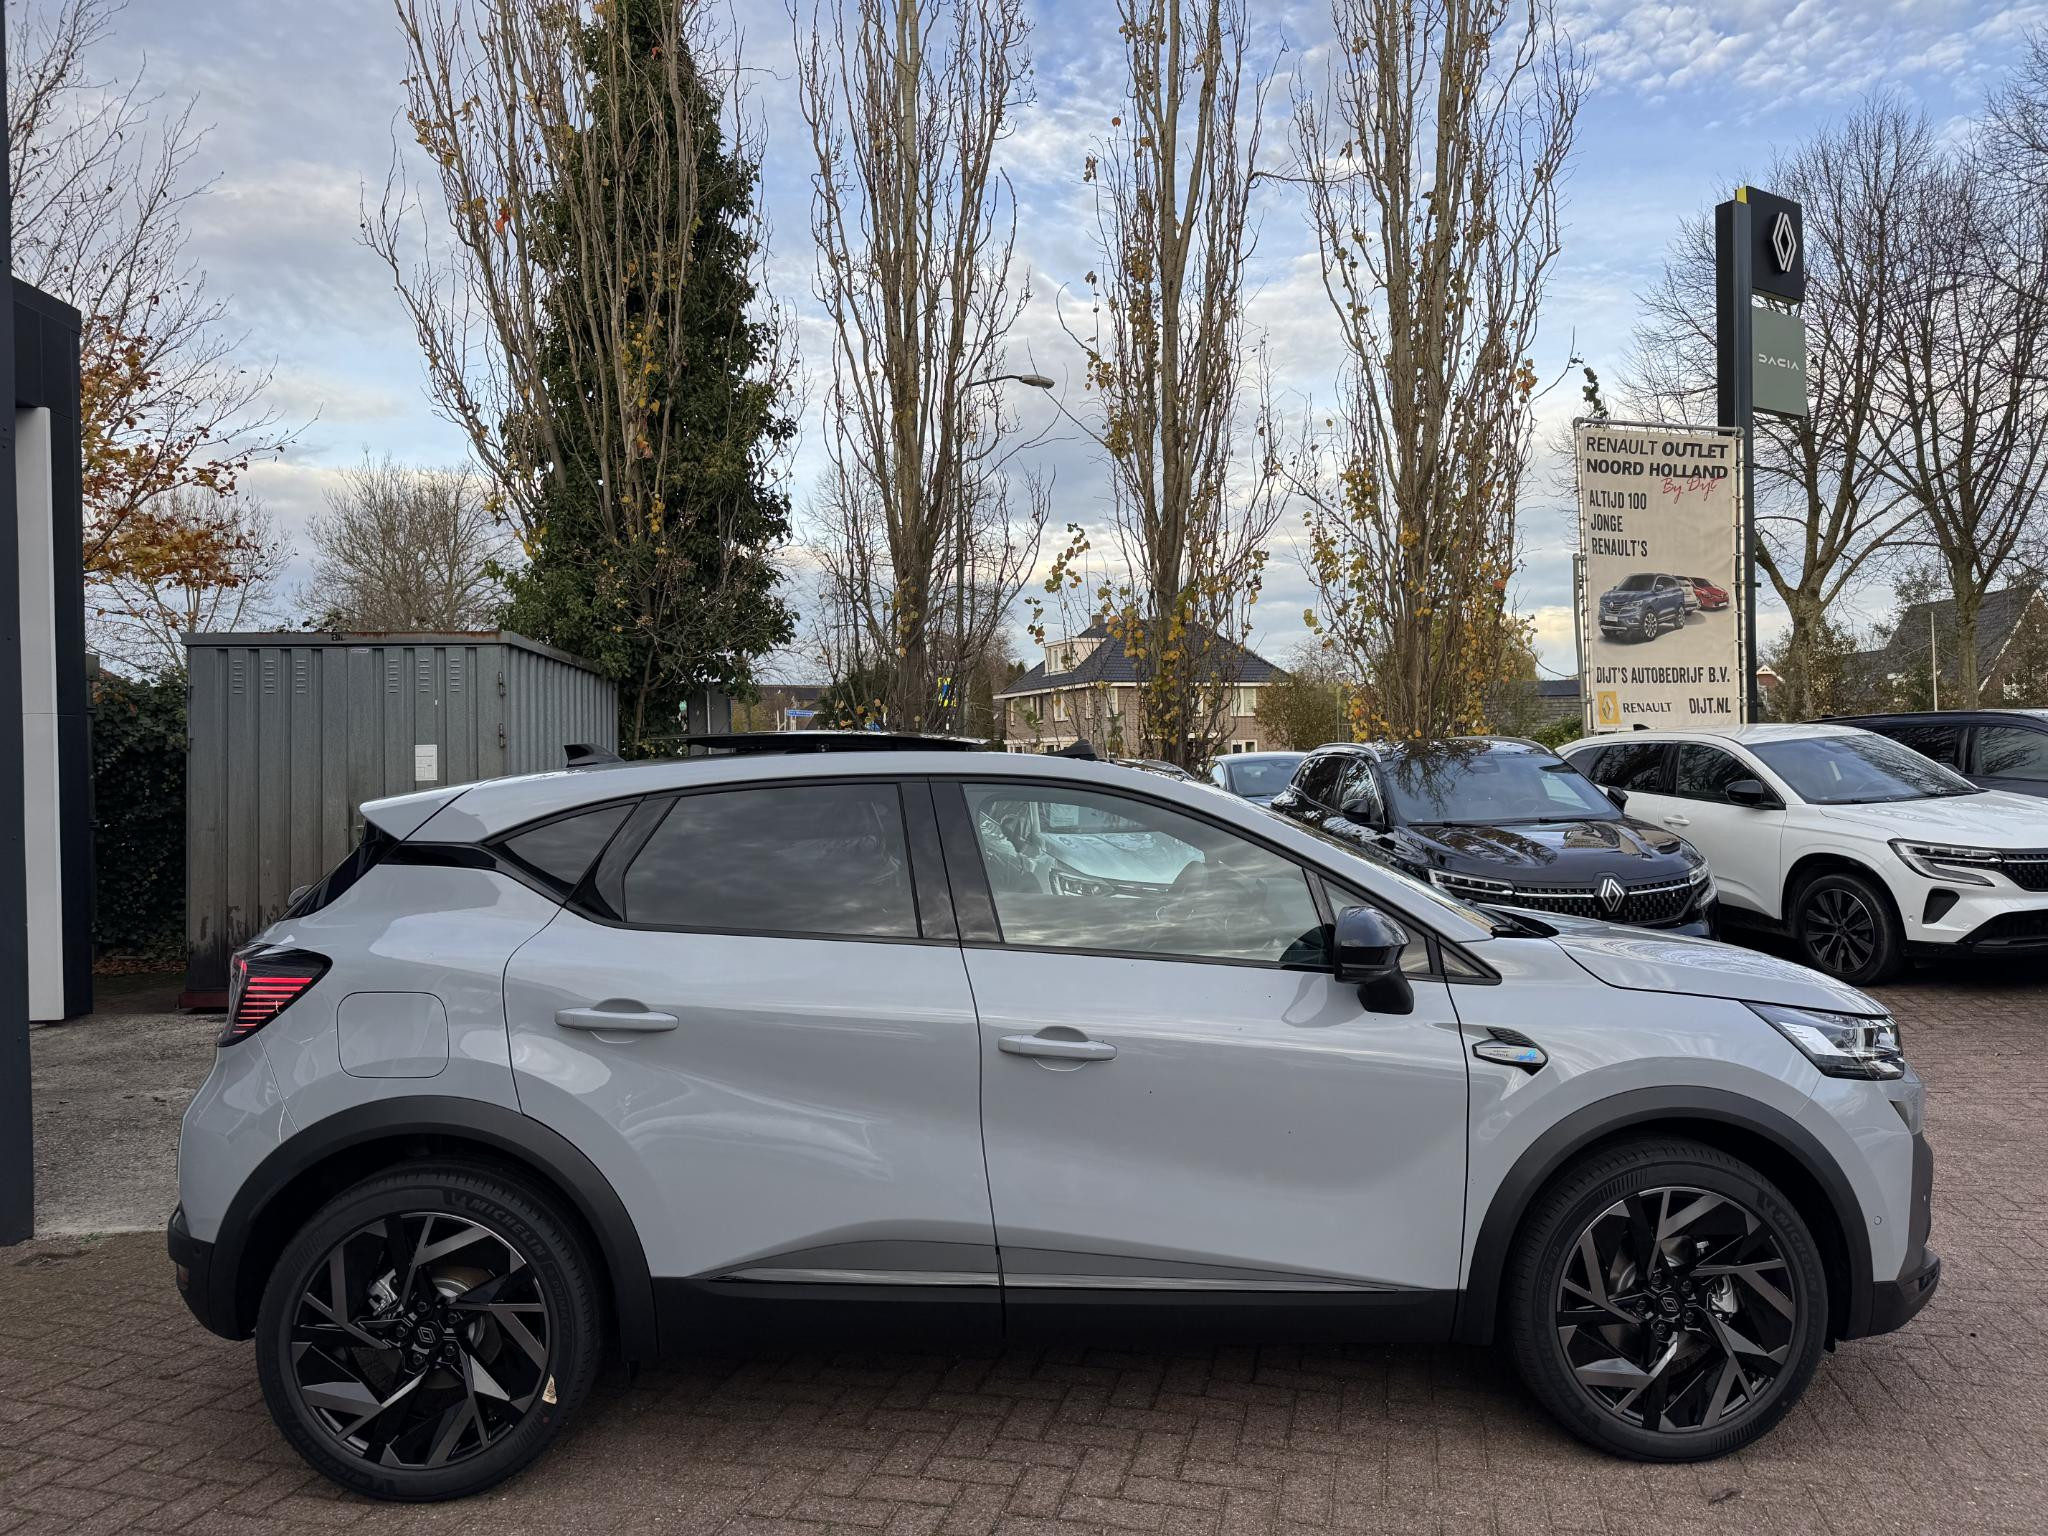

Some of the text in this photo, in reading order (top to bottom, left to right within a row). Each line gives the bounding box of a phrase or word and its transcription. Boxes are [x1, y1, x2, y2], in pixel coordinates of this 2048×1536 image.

[1758, 353, 1799, 370] DACIA
[1586, 436, 1729, 459] RENAULT OUTLET
[1586, 458, 1728, 479] NOORD HOLLAND
[1589, 489, 1647, 510] ALTIJD 100
[1662, 478, 1684, 504] By
[1590, 513, 1623, 533] JONGE
[1591, 537, 1648, 557] RENAULT'S
[1596, 666, 1731, 684] DIJT'S AUTOBEDRIJF B.V.
[1622, 702, 1672, 714] RENAULT
[1688, 697, 1732, 714] DIJT.NL
[469, 1200, 548, 1258] MICHELIN
